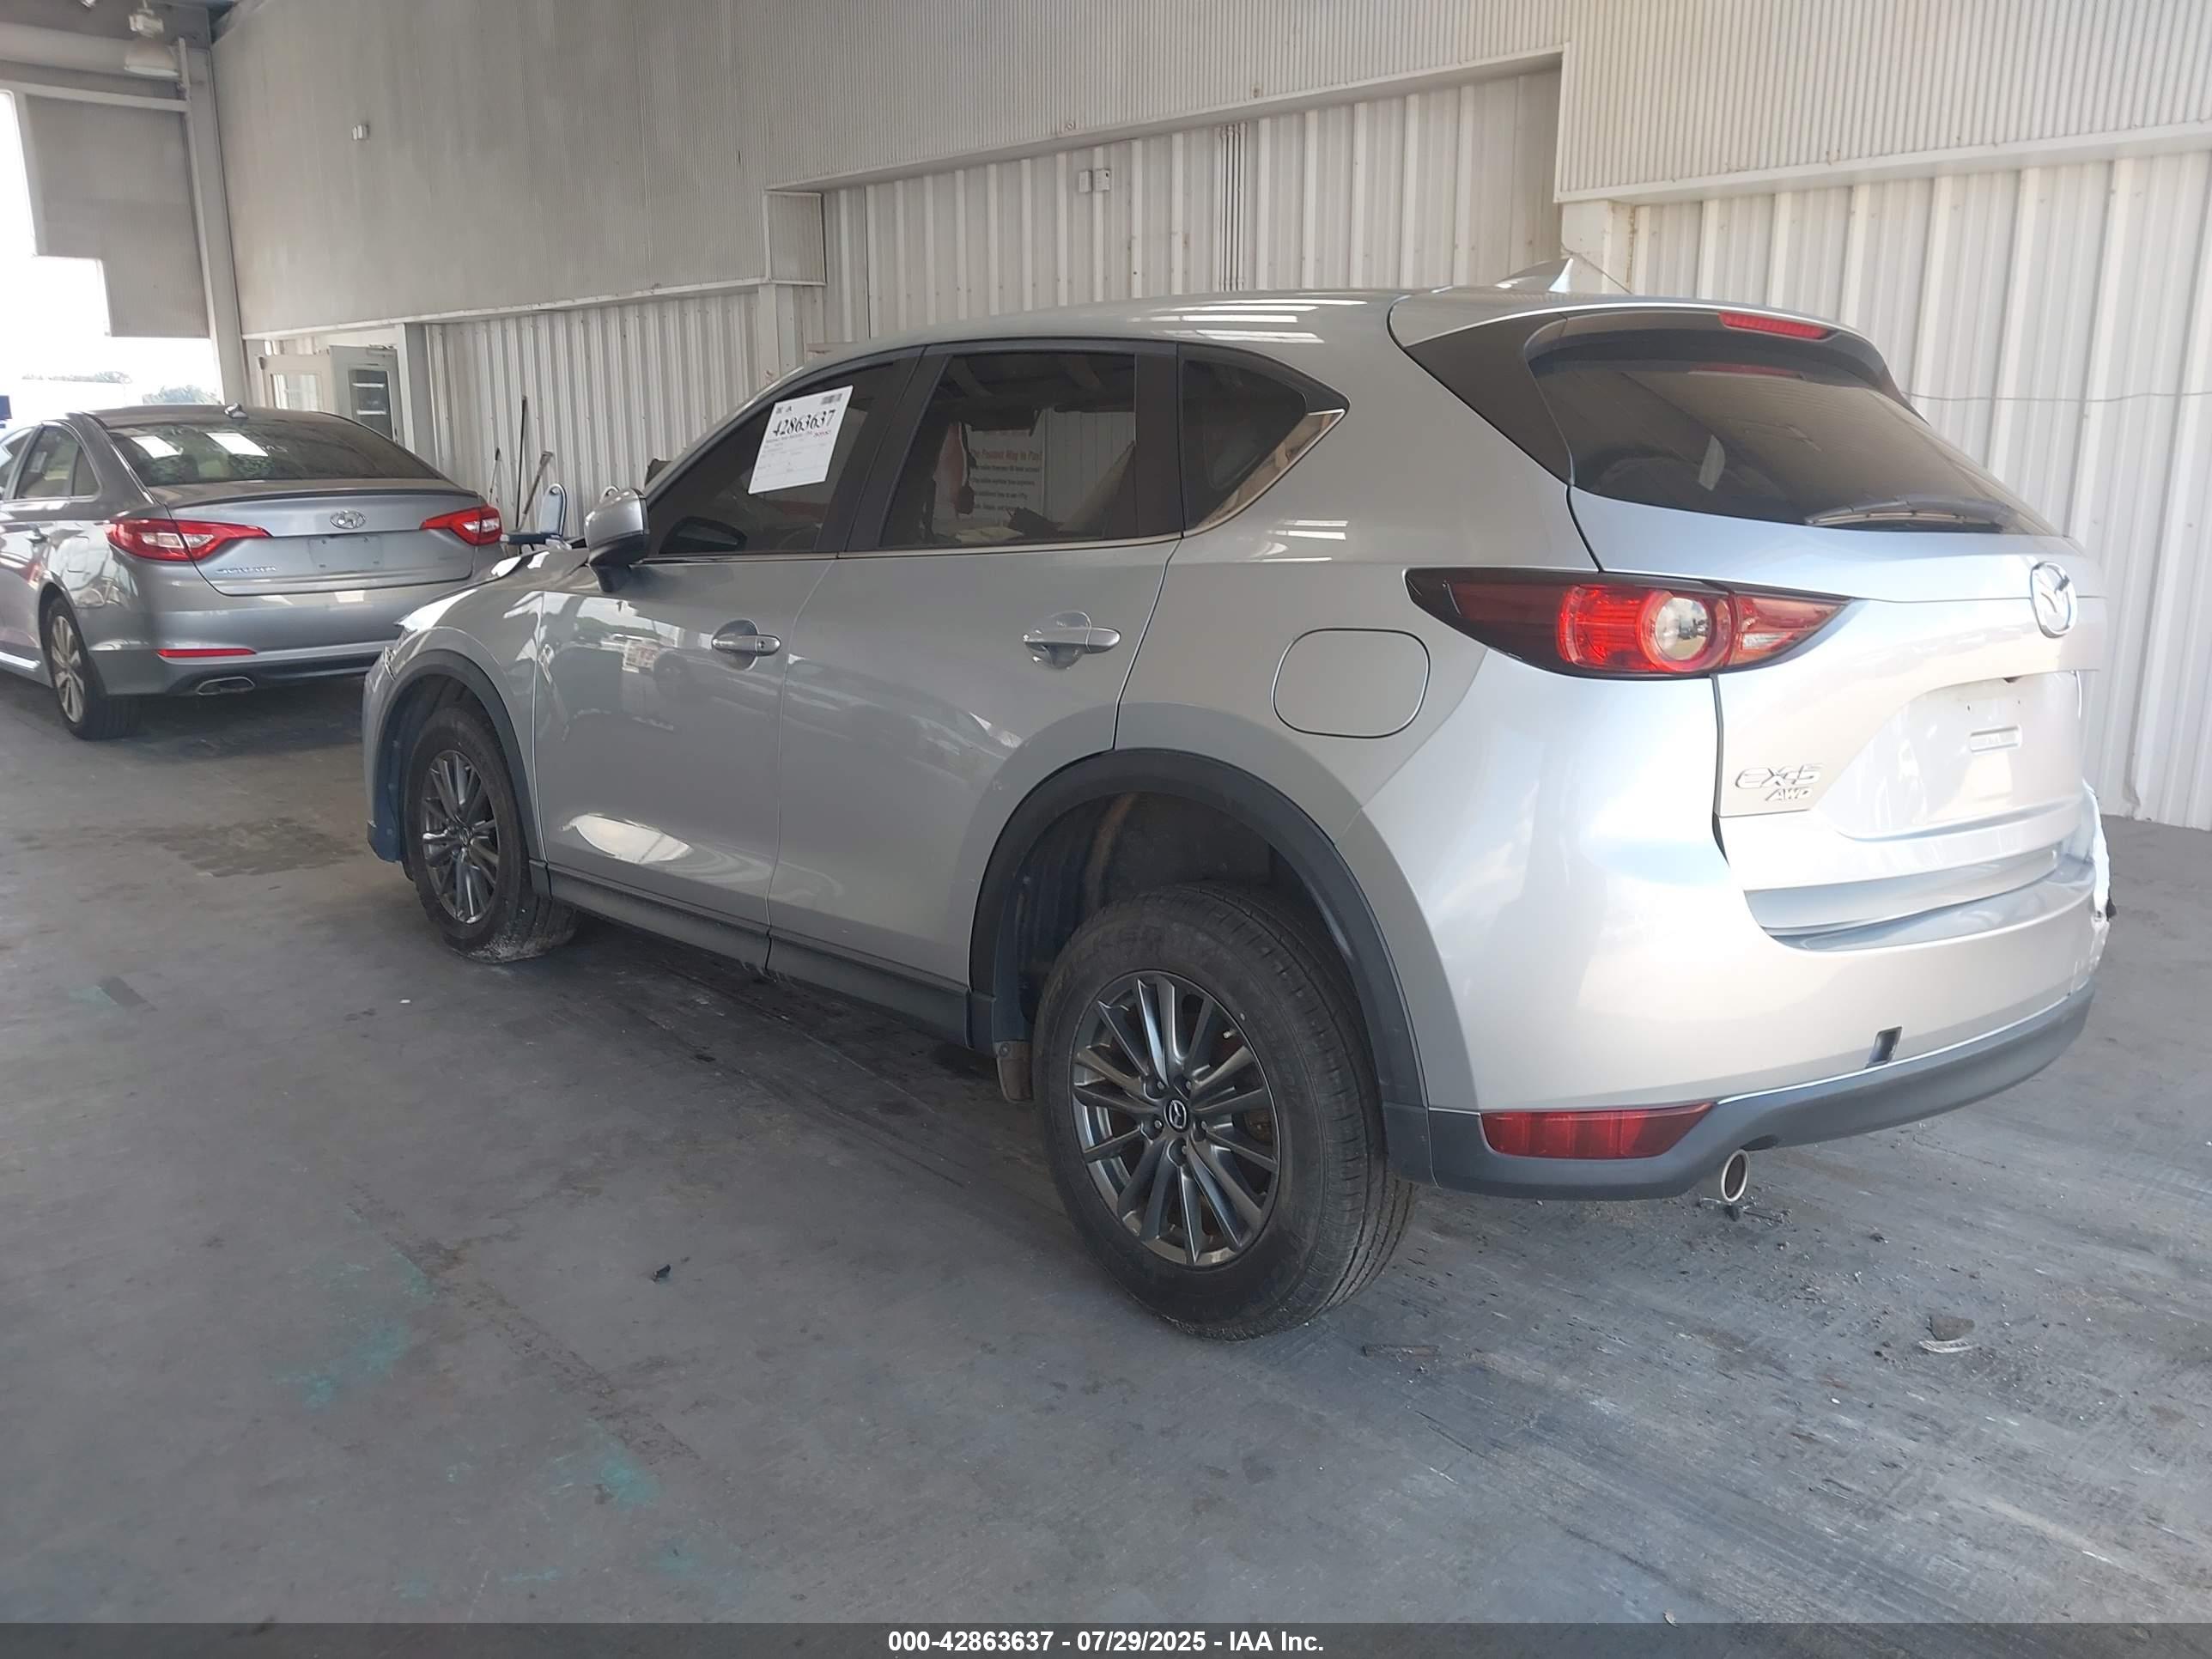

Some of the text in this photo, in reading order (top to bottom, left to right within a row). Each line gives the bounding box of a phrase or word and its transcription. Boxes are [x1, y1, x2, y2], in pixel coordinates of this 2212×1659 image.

[773, 409, 836, 437] 42863637
[1735, 762, 1826, 789] CX-5
[1765, 786, 1814, 801] AWD
